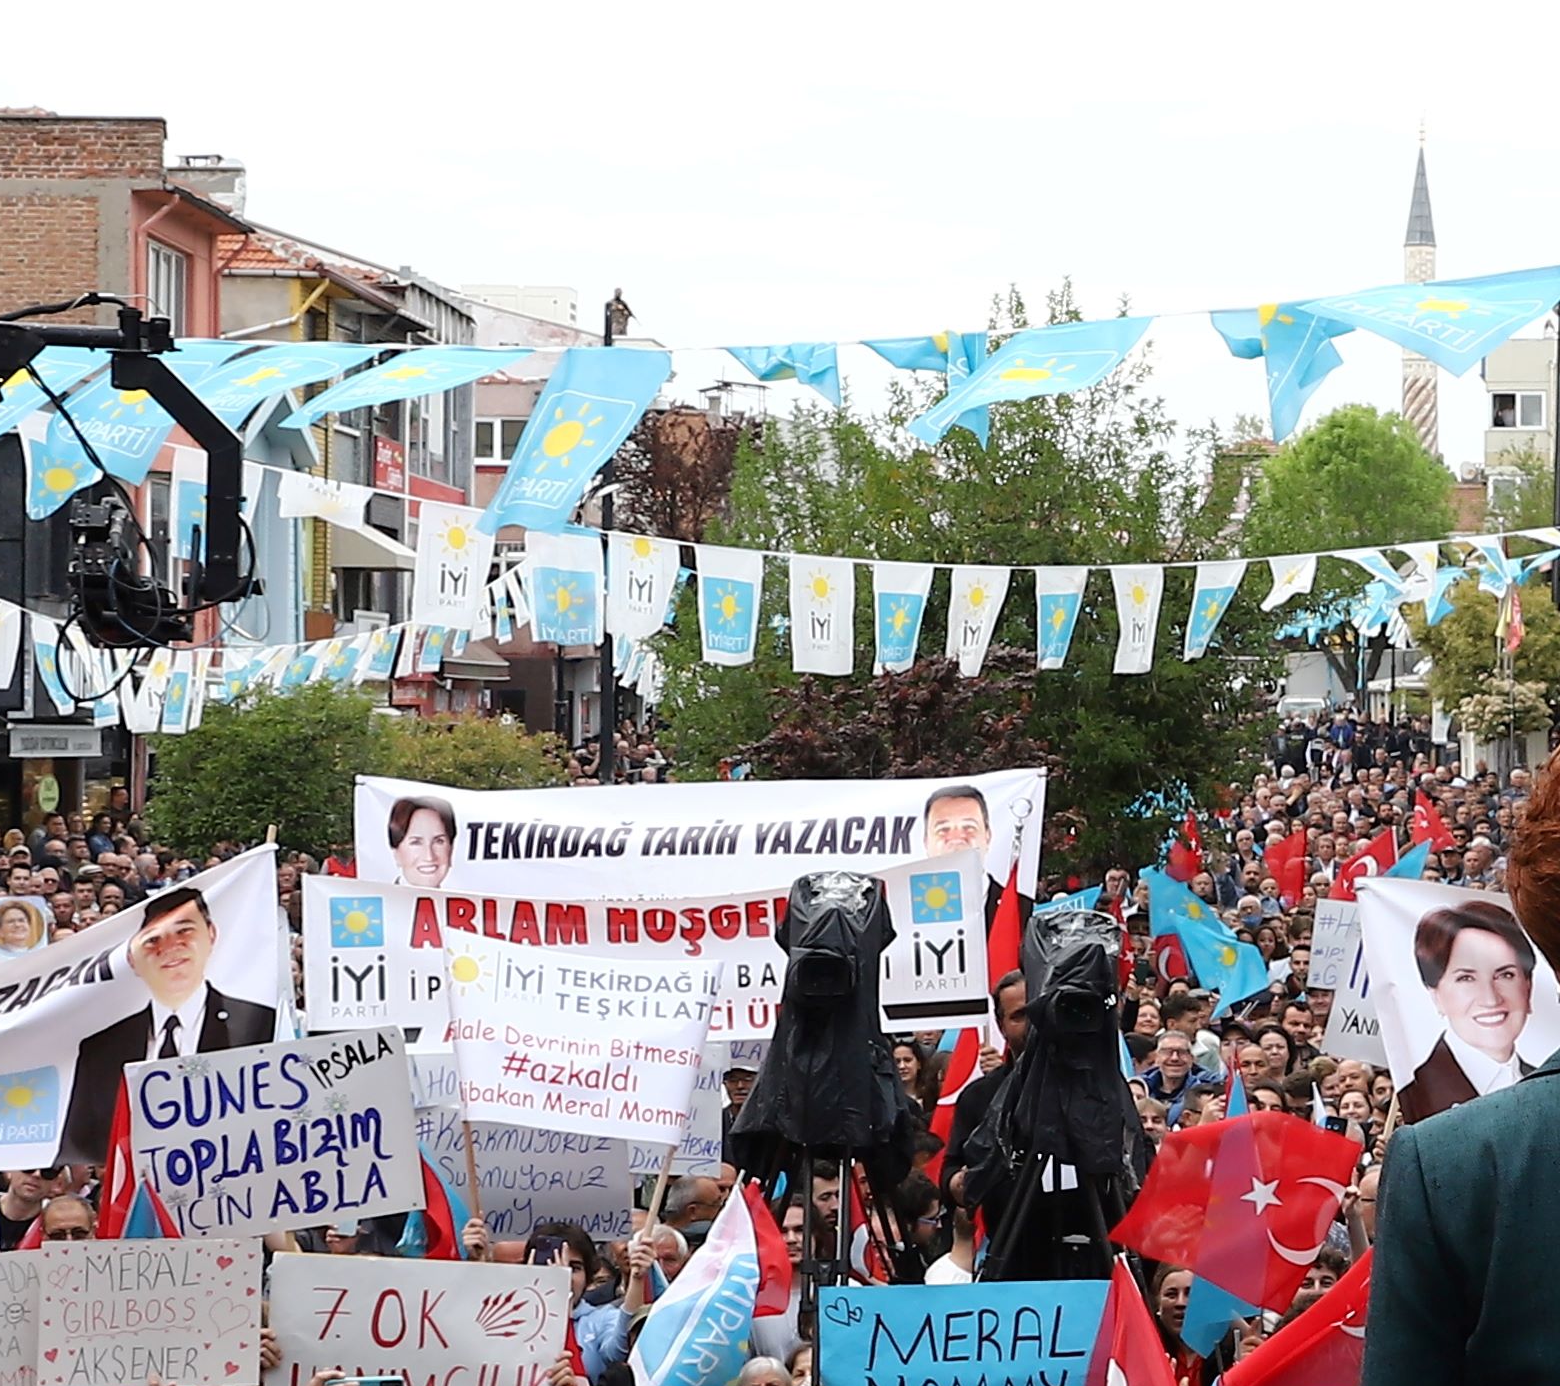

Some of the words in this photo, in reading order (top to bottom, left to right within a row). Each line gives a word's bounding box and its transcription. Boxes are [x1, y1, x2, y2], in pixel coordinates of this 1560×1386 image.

[466, 817, 636, 862] TEKİRDAĞ
[640, 819, 743, 857] TARİH
[754, 815, 918, 856] YAZACAK
[912, 929, 966, 976] İYİ
[331, 954, 386, 1003] İYİ
[505, 958, 544, 995] İYİ
[557, 966, 693, 994] TEKİRDAĞ
[914, 974, 969, 992] PARTİ
[331, 1005, 388, 1018] PARTİ
[501, 1050, 638, 1094] #azkaldı
[543, 1092, 610, 1119] Meral
[6, 1120, 56, 1141] PARTİ
[140, 1130, 265, 1197] TOPLA
[270, 1163, 389, 1219] ABLA
[85, 1250, 200, 1293] MERAL
[864, 1304, 1087, 1372] MERAL
